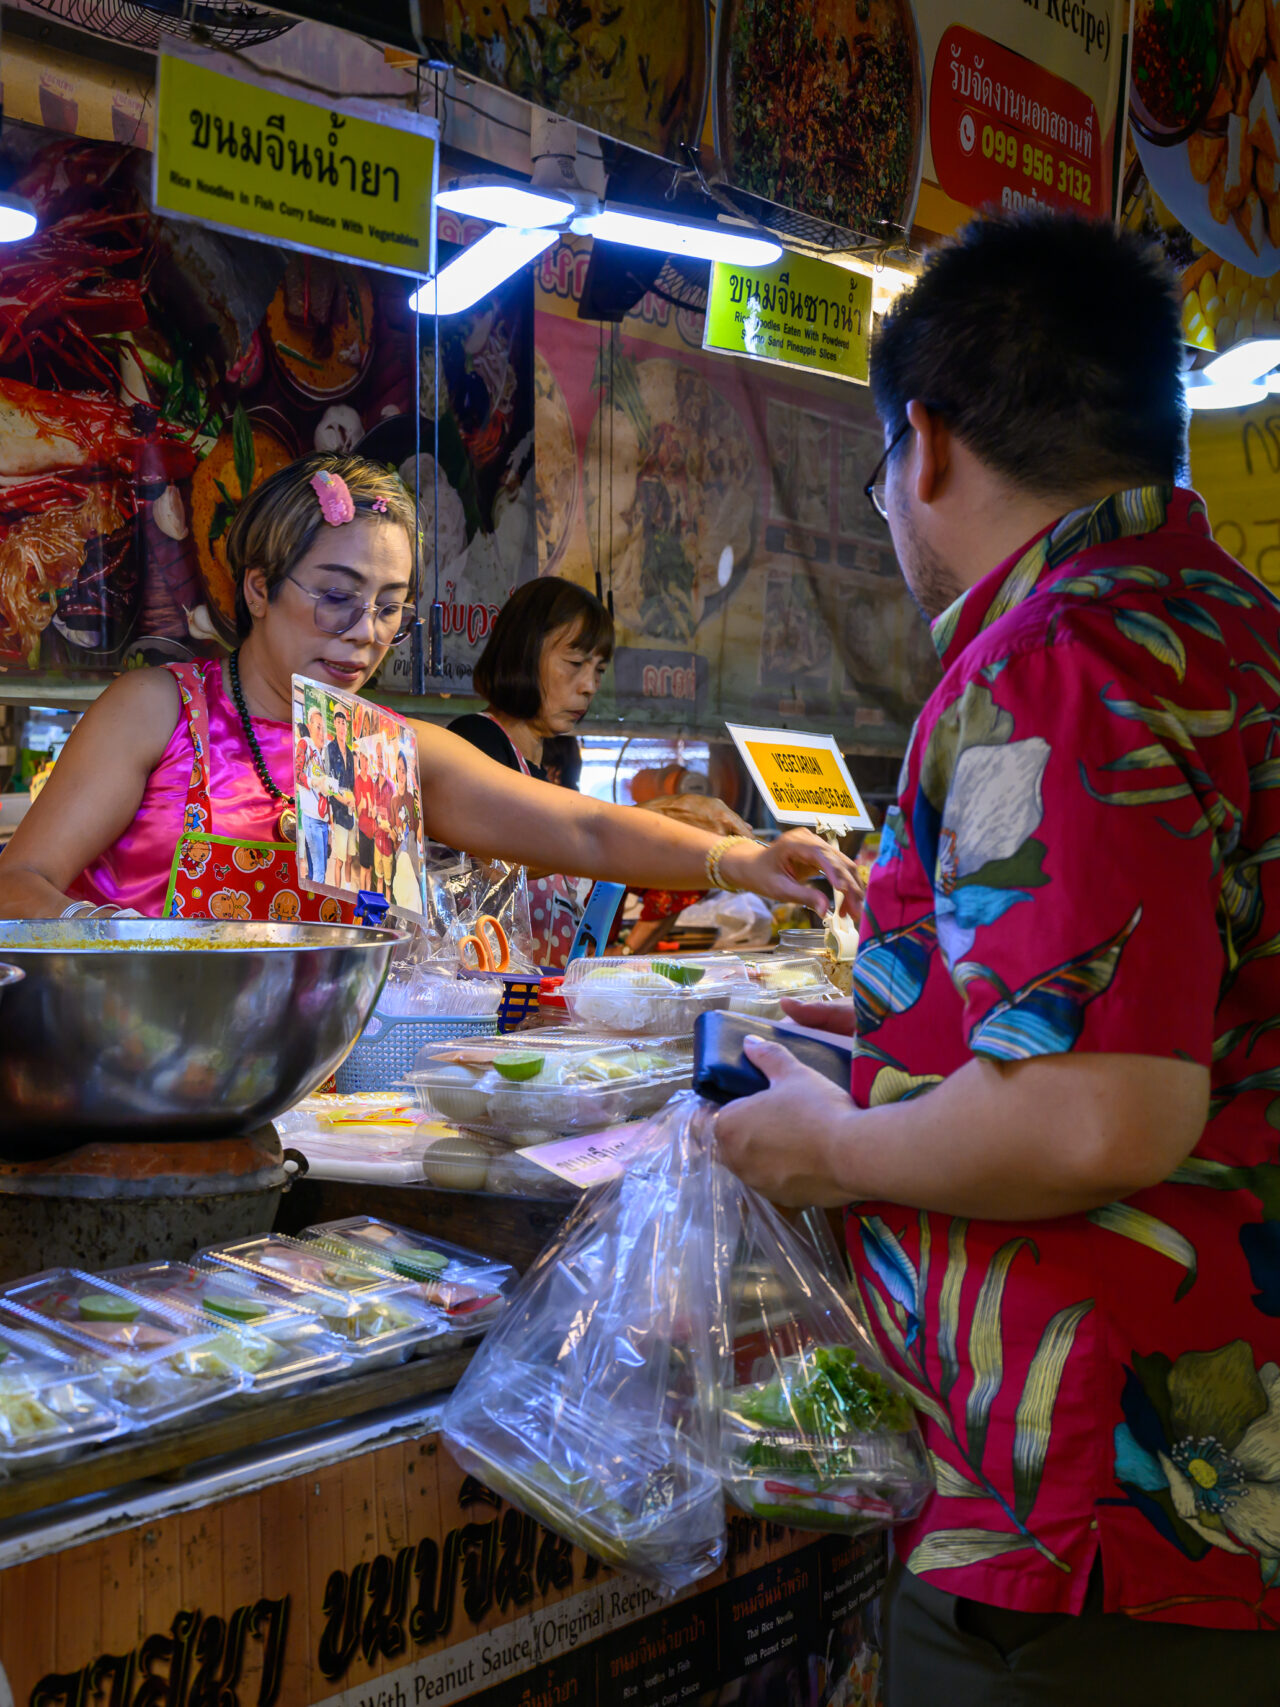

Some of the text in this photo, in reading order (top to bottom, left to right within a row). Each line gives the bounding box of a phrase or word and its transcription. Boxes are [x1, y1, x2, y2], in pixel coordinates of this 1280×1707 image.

[949, 43, 1094, 159] รับจัดงานนอกสถานที่
[188, 109, 400, 203] ขนมจีนน้ำยา
[981, 125, 1018, 169] 099
[1022, 143, 1054, 187] 956
[1057, 160, 1092, 207] 3132
[169, 169, 192, 190] Rice
[196, 179, 235, 203] Noodles
[254, 194, 274, 213] Fish
[279, 202, 305, 222] Curry
[307, 209, 337, 229] Sauce
[341, 218, 363, 236] With
[368, 225, 420, 249] Vegetables
[729, 271, 862, 336] ขนมจีนซาวน้ำ
[783, 322, 802, 338] Eaten
[804, 326, 820, 342] With
[821, 332, 850, 350] Powdered
[767, 335, 784, 350] Sand
[786, 338, 817, 358] Pineapple
[819, 348, 838, 362] Slices
[770, 751, 824, 777] VEGETARIAN
[415, 1659, 475, 1705] Peanut
[481, 1639, 530, 1677] Sauce
